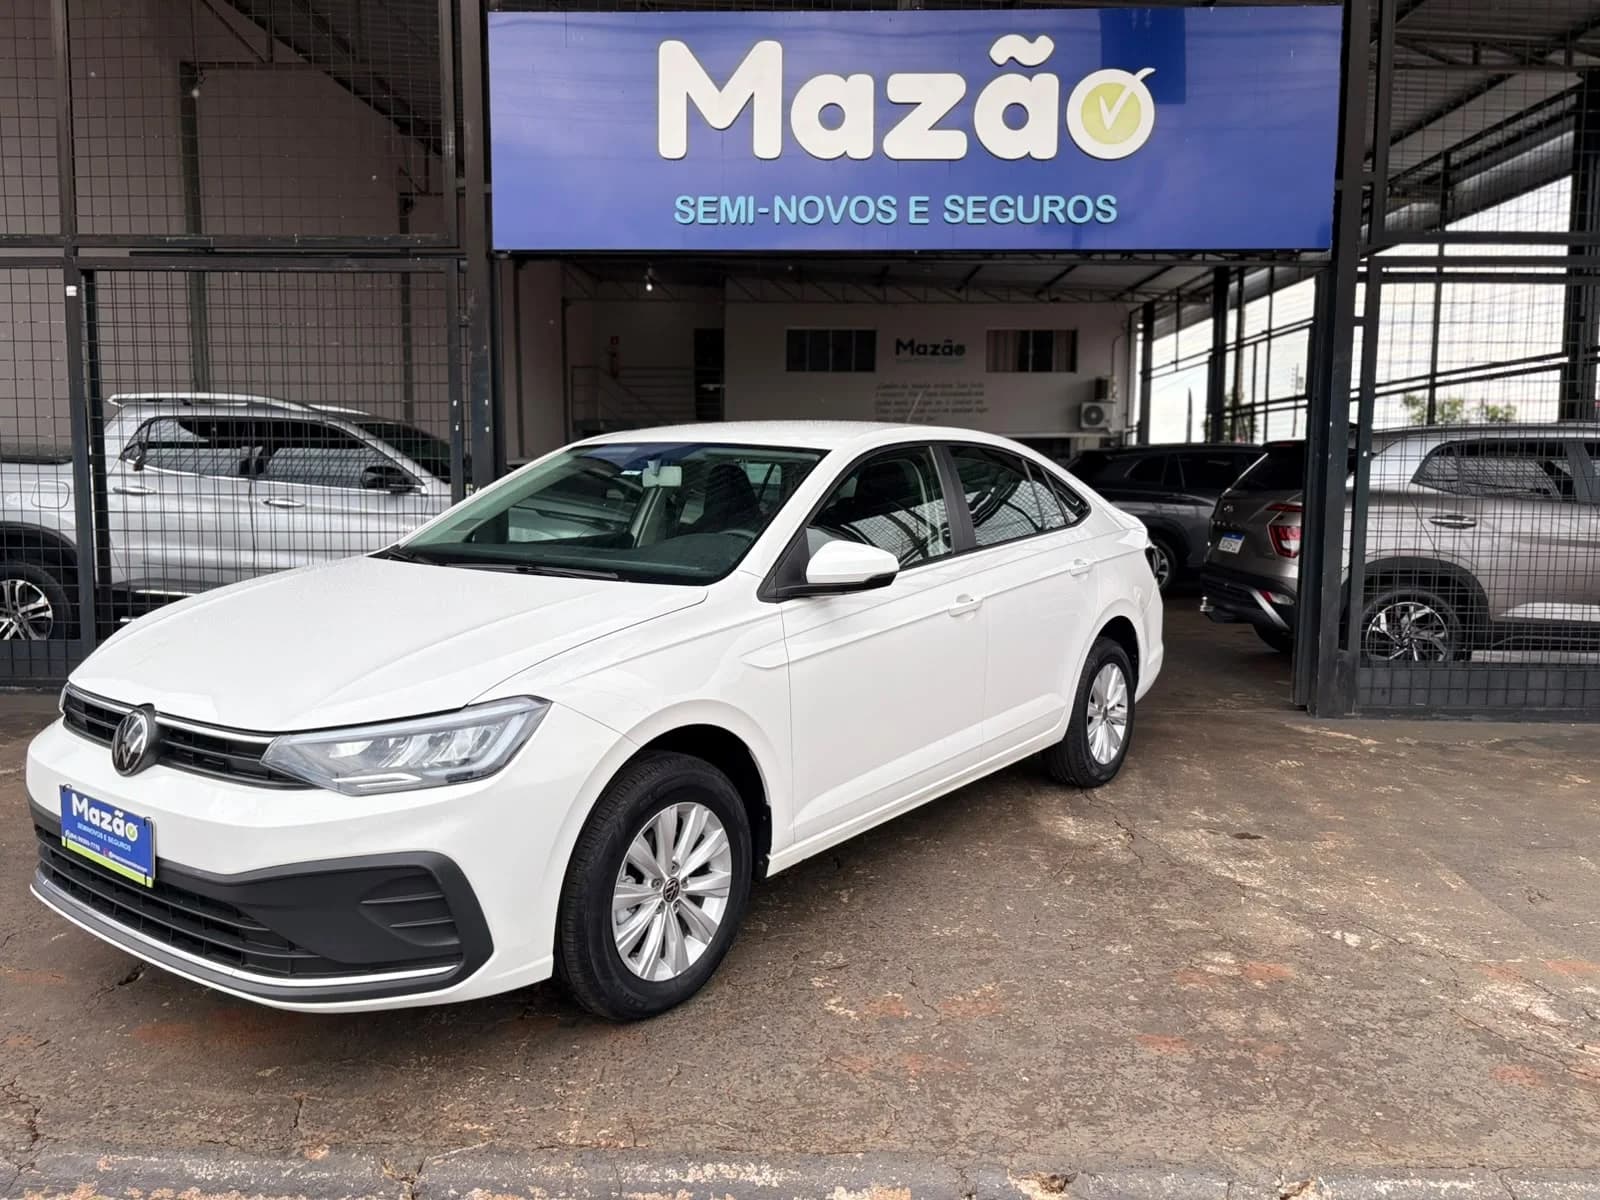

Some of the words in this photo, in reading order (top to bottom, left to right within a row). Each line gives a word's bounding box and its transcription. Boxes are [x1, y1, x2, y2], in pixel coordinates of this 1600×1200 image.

[657, 34, 1156, 162] Mazão
[674, 195, 898, 226] SEMI-NOVOS
[908, 196, 930, 225] E
[943, 194, 1118, 226] SEGUROS
[895, 337, 966, 357] Mazão
[71, 792, 139, 842] Mazão
